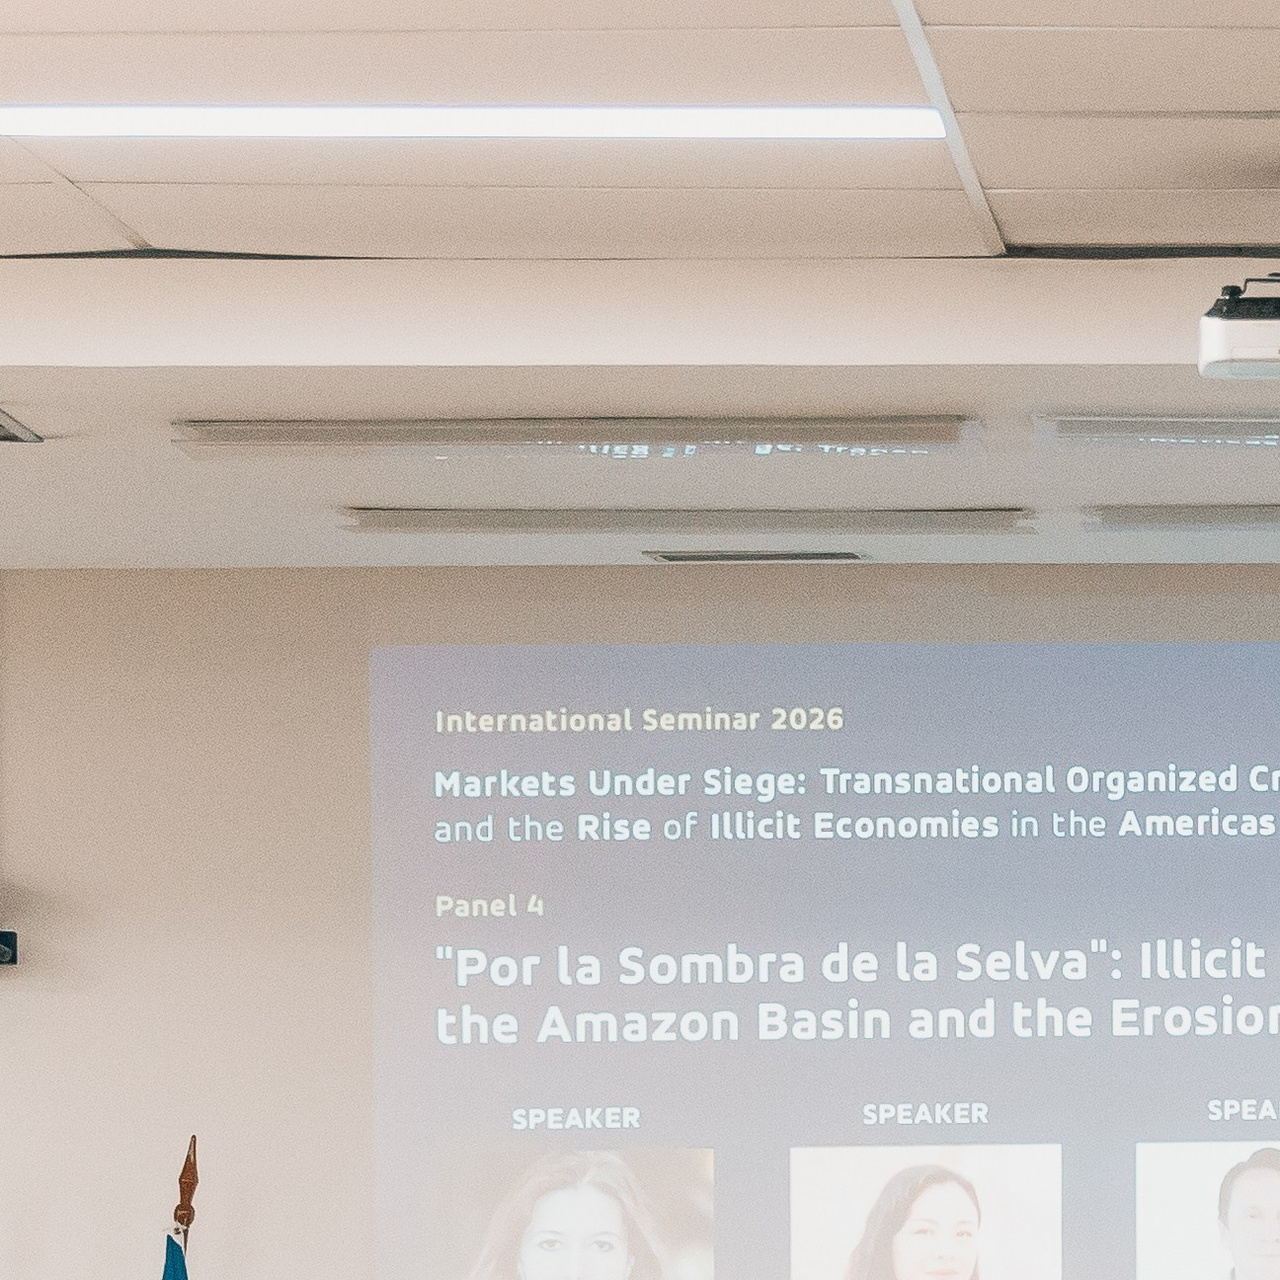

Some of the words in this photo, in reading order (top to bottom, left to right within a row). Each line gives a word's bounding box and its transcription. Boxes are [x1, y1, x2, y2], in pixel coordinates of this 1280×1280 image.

[435, 708, 633, 733] International
[642, 708, 760, 731] Seminar
[772, 707, 844, 730] 2026
[434, 770, 576, 797] Markets
[589, 769, 691, 796] Under
[703, 766, 807, 802] Siege:
[820, 764, 1055, 795] Transnational
[1066, 763, 1238, 799] Organized
[434, 815, 494, 842] and
[507, 814, 565, 841] the
[579, 813, 651, 840] Rise
[663, 812, 698, 840] of
[710, 811, 802, 840] Illicit
[813, 809, 999, 839] Economies
[1011, 809, 1039, 837] in
[1051, 809, 1106, 837] the
[1118, 807, 1276, 836] Americas
[435, 894, 518, 917] Panel
[526, 894, 545, 916] 4
[435, 944, 541, 986] "Por
[557, 945, 602, 985] la
[618, 942, 805, 985] Sombra
[821, 942, 880, 982] de
[896, 941, 939, 981] la
[956, 938, 1123, 981] Selva":
[1140, 937, 1266, 979] Illicit
[436, 1004, 519, 1044] the
[536, 1004, 739, 1043] Amazon
[757, 998, 891, 1040] Basin
[907, 998, 996, 1040] and
[1011, 997, 1093, 1038] the
[511, 1107, 642, 1130] SPEAKER
[862, 1102, 990, 1126] SPEAKER
